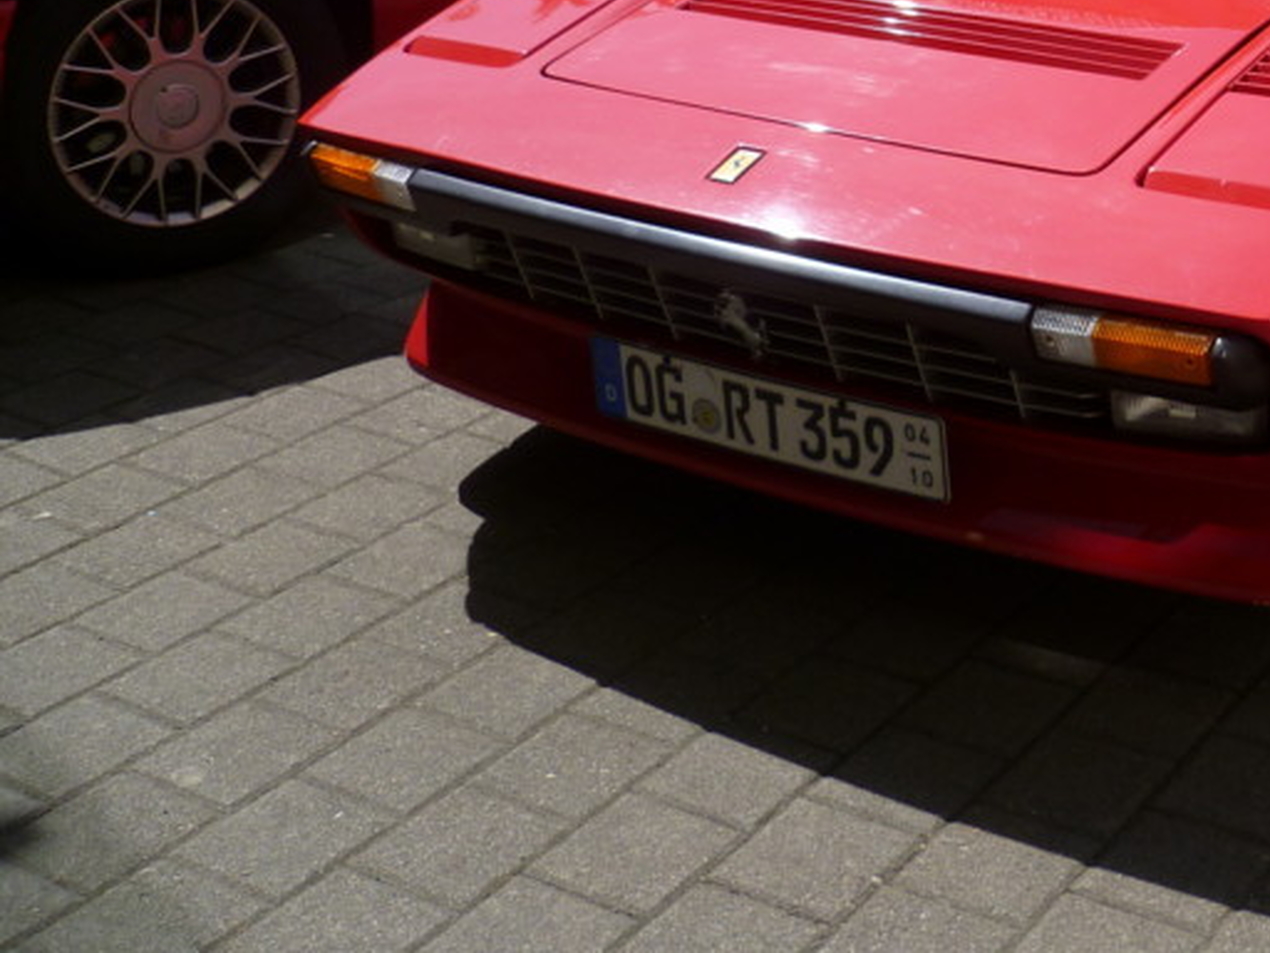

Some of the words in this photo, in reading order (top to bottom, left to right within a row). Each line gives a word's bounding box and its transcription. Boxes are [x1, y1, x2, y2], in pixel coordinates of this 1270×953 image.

[625, 356, 688, 427] OG
[722, 379, 784, 452] RT
[795, 397, 894, 478] 359
[904, 424, 931, 446] 04
[911, 467, 935, 488] 10
